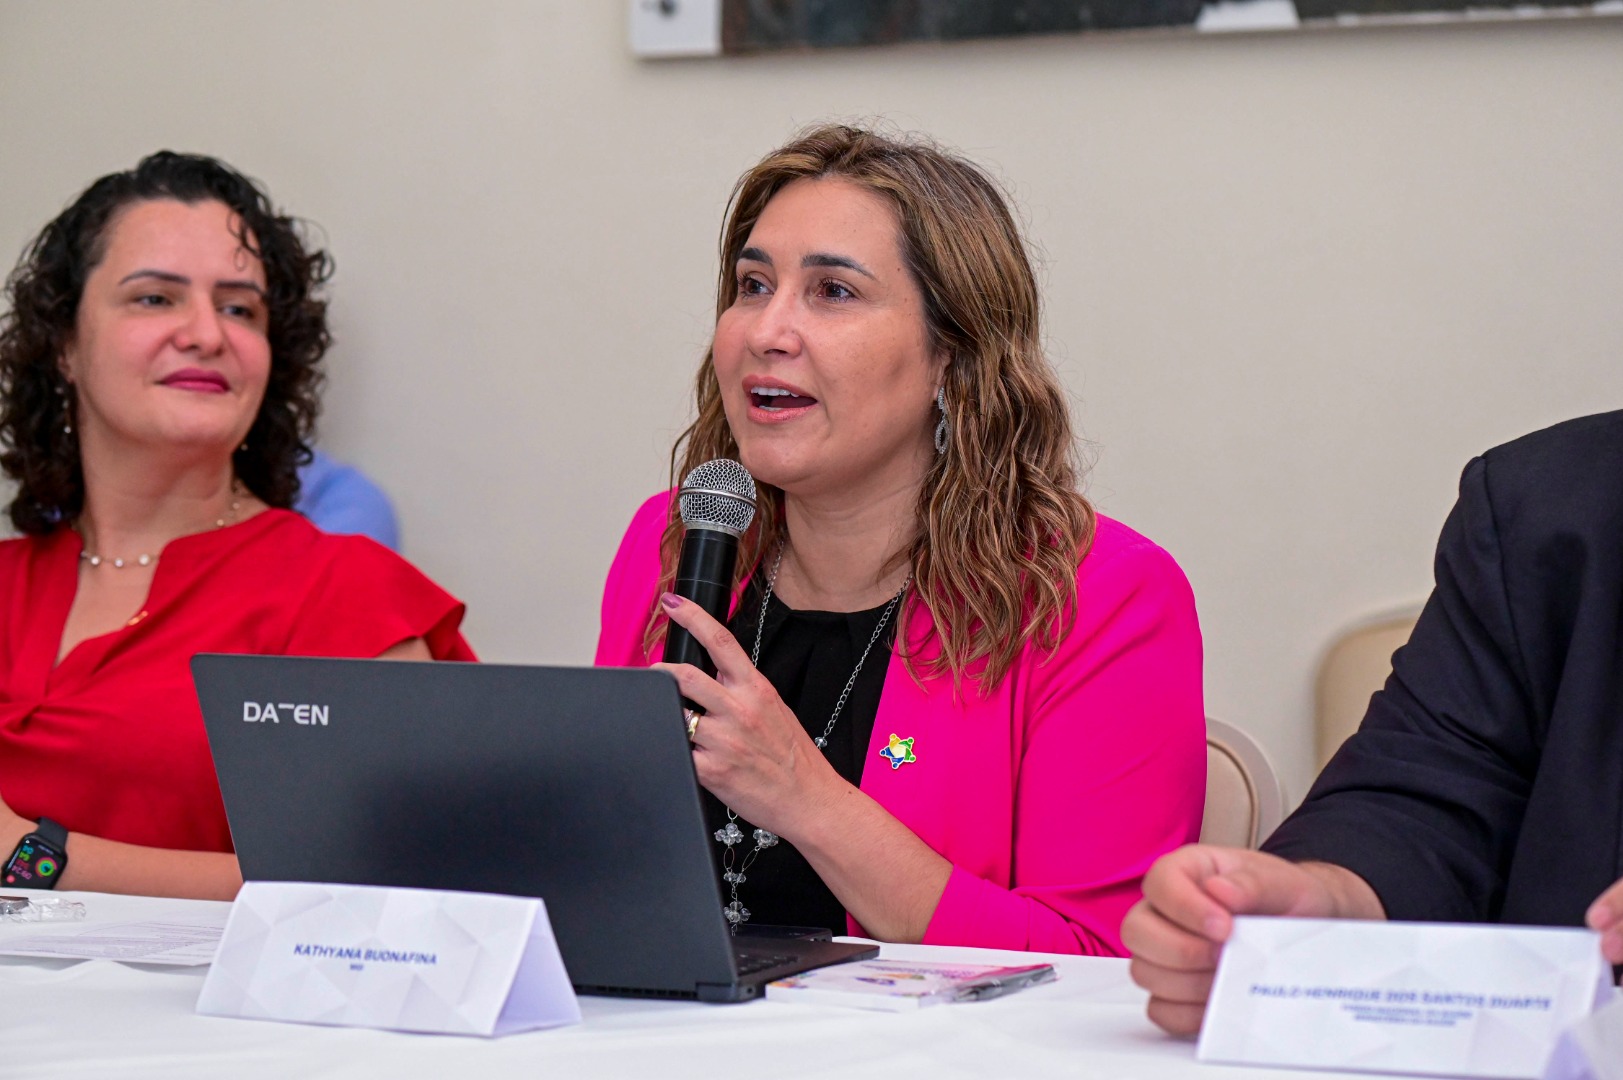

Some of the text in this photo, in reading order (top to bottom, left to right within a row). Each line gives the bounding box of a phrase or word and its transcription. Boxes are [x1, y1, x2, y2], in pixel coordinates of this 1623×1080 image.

[243, 701, 329, 726] DATEN
[294, 943, 437, 964] KATHYANA BUONAFINA
[1304, 986, 1381, 1001] HENRIQUE
[1422, 991, 1485, 1006] SANTOS
[1490, 995, 1552, 1010] DUARTE
